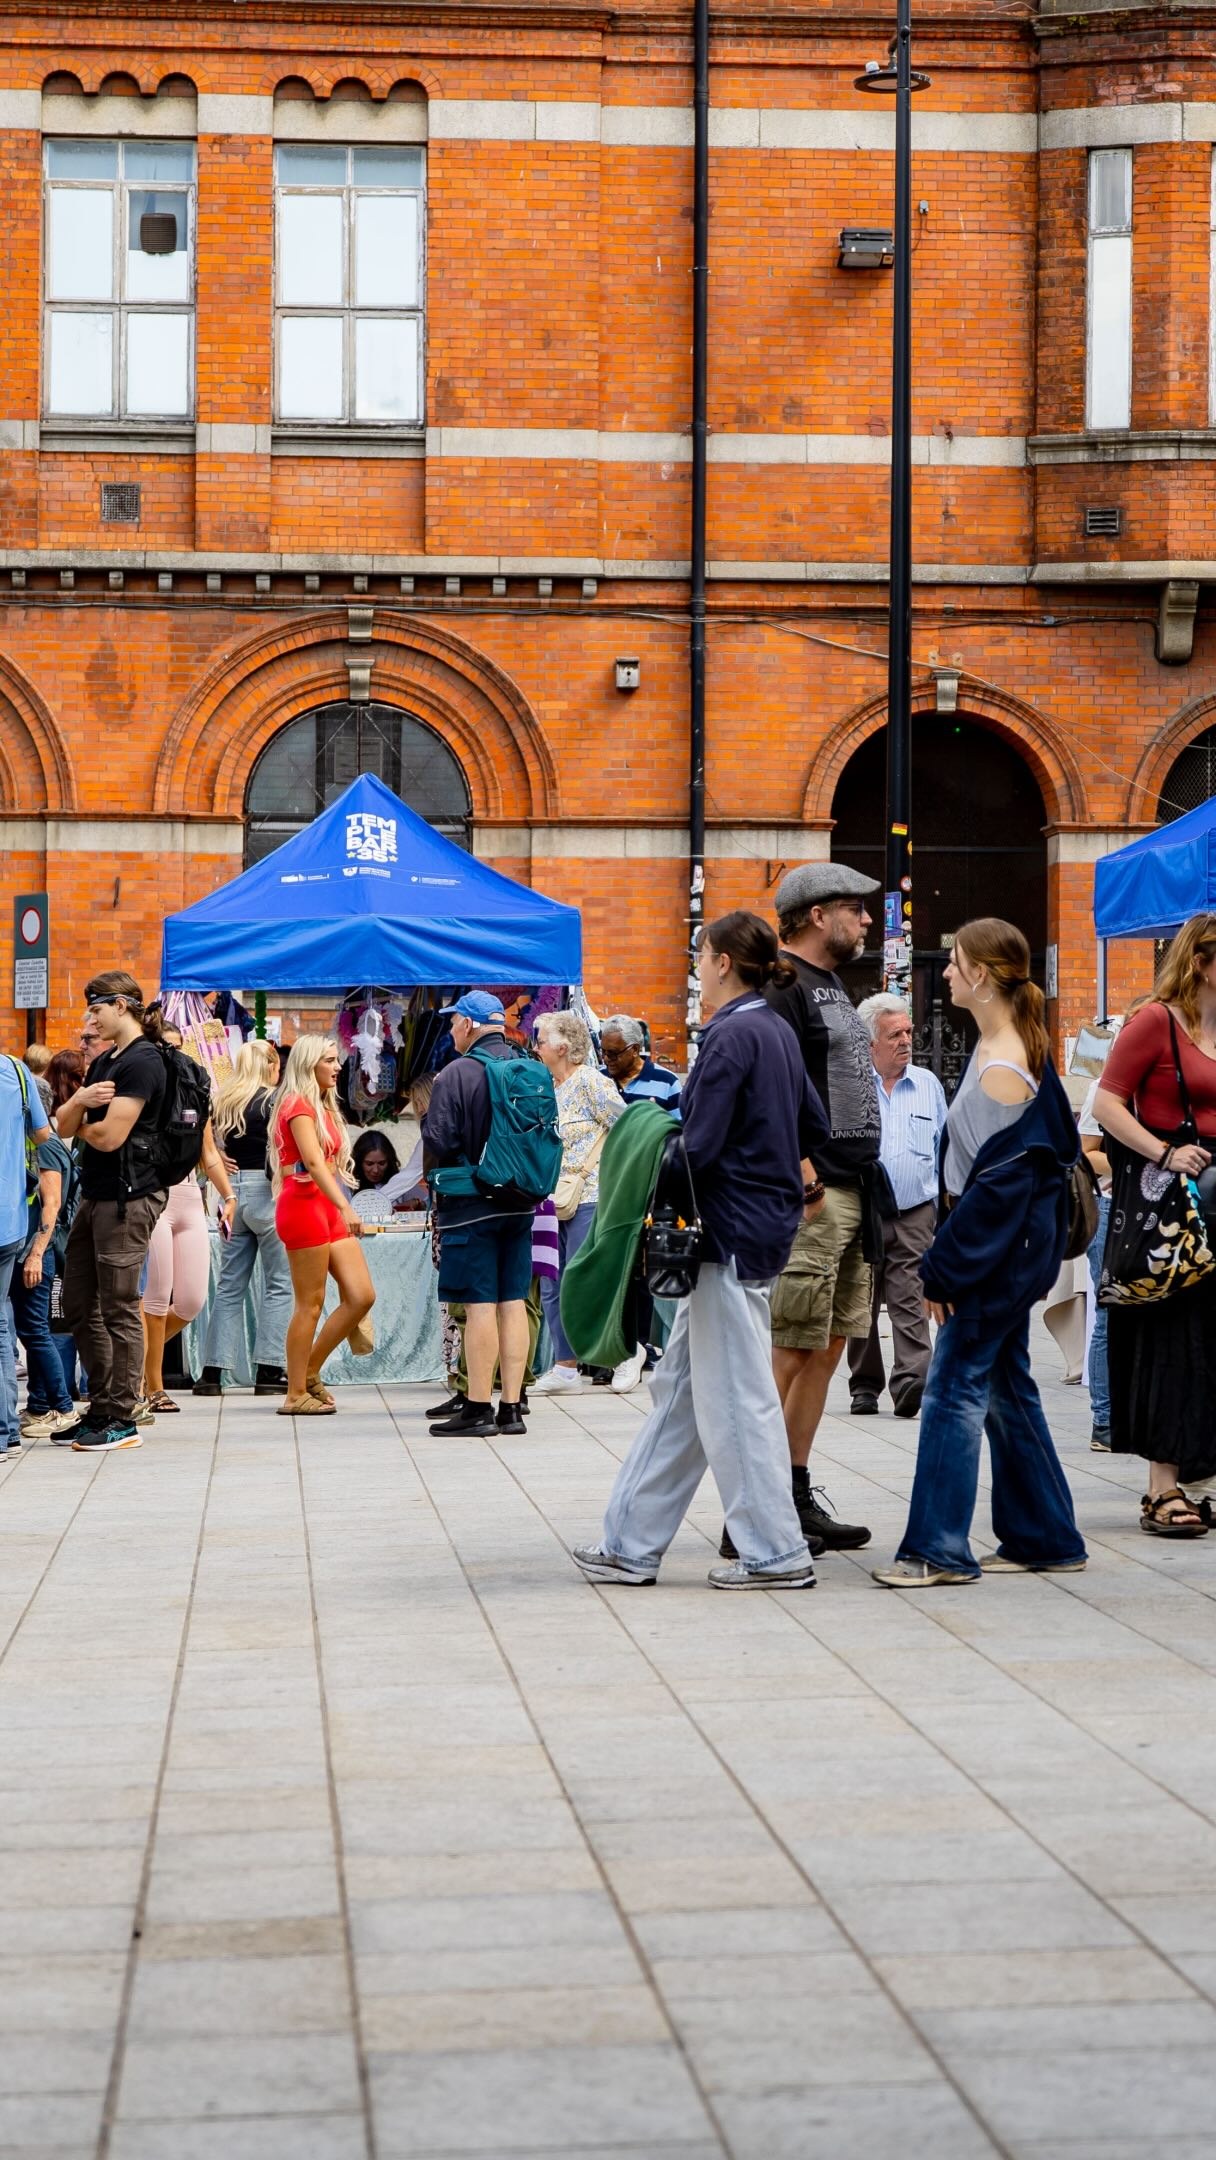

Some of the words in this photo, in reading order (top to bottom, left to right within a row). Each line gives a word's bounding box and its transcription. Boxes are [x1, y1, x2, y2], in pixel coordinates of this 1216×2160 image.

[345, 812, 397, 832] TEM
[346, 824, 396, 841] PLE
[346, 836, 398, 855] BAR
[356, 848, 388, 863] 35
[811, 987, 831, 1003] JOY
[830, 1129, 876, 1139] UNKNOWN
